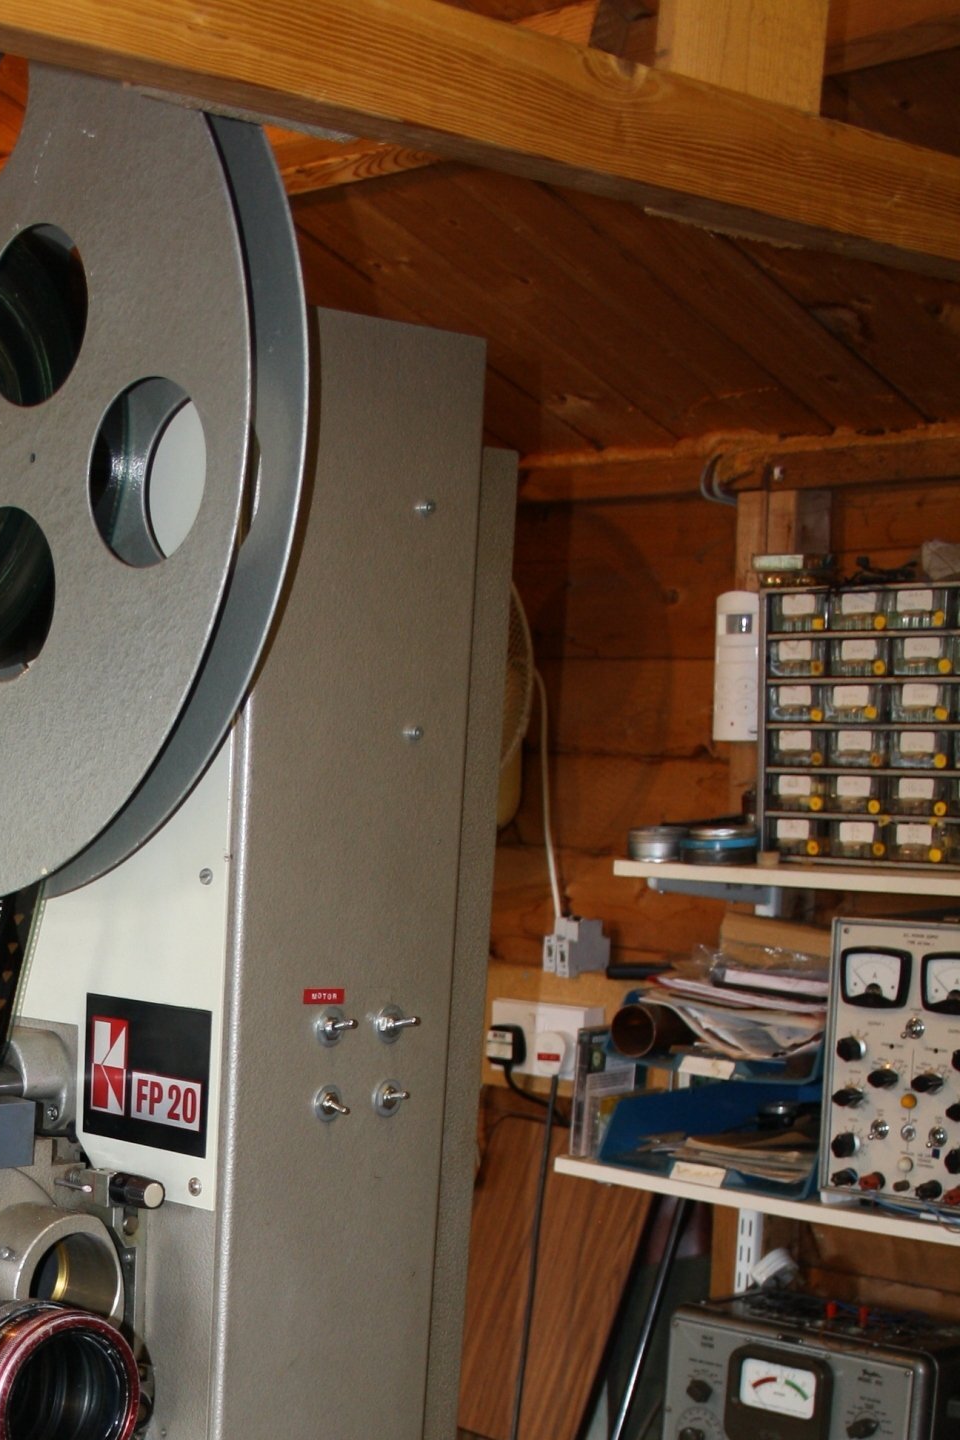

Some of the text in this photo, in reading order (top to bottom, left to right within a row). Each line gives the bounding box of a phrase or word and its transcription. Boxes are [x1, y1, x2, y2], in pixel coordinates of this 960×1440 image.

[311, 992, 338, 1001] MOTOR
[136, 1078, 197, 1125] FP 20
